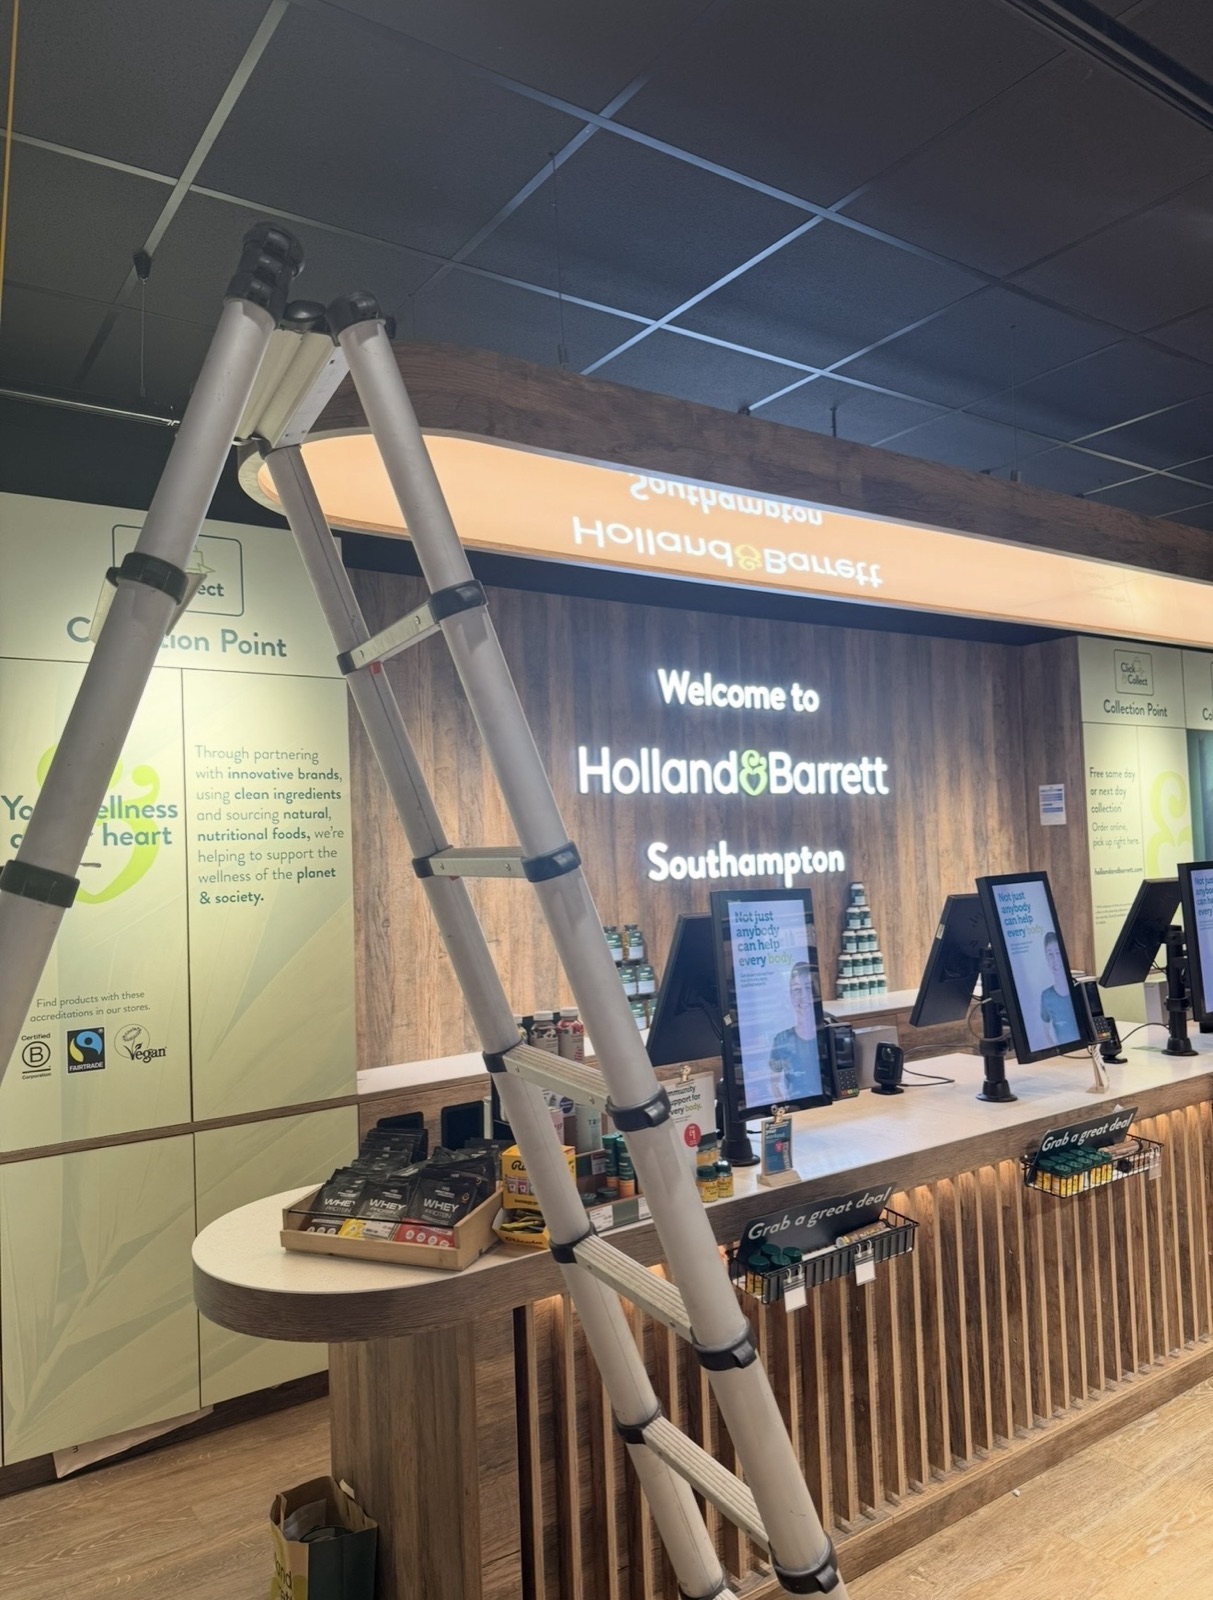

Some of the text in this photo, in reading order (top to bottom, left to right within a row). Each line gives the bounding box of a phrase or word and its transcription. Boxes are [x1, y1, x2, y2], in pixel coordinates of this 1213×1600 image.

[221, 628, 287, 657] Point
[1121, 662, 1136, 673] Click
[1127, 674, 1148, 686] Collect
[657, 669, 820, 712] Welcome to
[1103, 699, 1168, 717] Collection Point
[195, 744, 320, 765] Through partnering
[195, 766, 343, 782] with innovative brands,
[1089, 767, 1104, 778] Free
[1124, 768, 1136, 782] day
[196, 787, 342, 804] using clean ingredients
[1099, 788, 1114, 796] next
[1114, 785, 1127, 799] day
[1, 795, 179, 821] Yo ellness
[197, 806, 332, 824] and sourcing natural,
[102, 823, 173, 846] heart
[197, 825, 344, 841] nutritional foods, we're
[198, 846, 338, 867] helping to support the
[647, 841, 845, 887] Southampton
[198, 866, 337, 884] wellness of the planet
[199, 890, 265, 906] & society.
[735, 911, 774, 924] Not just
[736, 924, 780, 940] anybody
[737, 938, 780, 952] can help
[739, 956, 767, 968] every
[36, 990, 145, 1009] Find products with these
[30, 1004, 152, 1023] accreditations in our stores.
[21, 1033, 51, 1041] Certified
[29, 1046, 44, 1063] B
[122, 1043, 166, 1063] Vegan
[69, 1061, 104, 1072] FAIRTRADE
[1042, 1113, 1134, 1151] Grab a great deal
[369, 1198, 406, 1211] WHEY
[423, 1198, 459, 1212] WHEY
[748, 1186, 892, 1239] Grab a great deal
